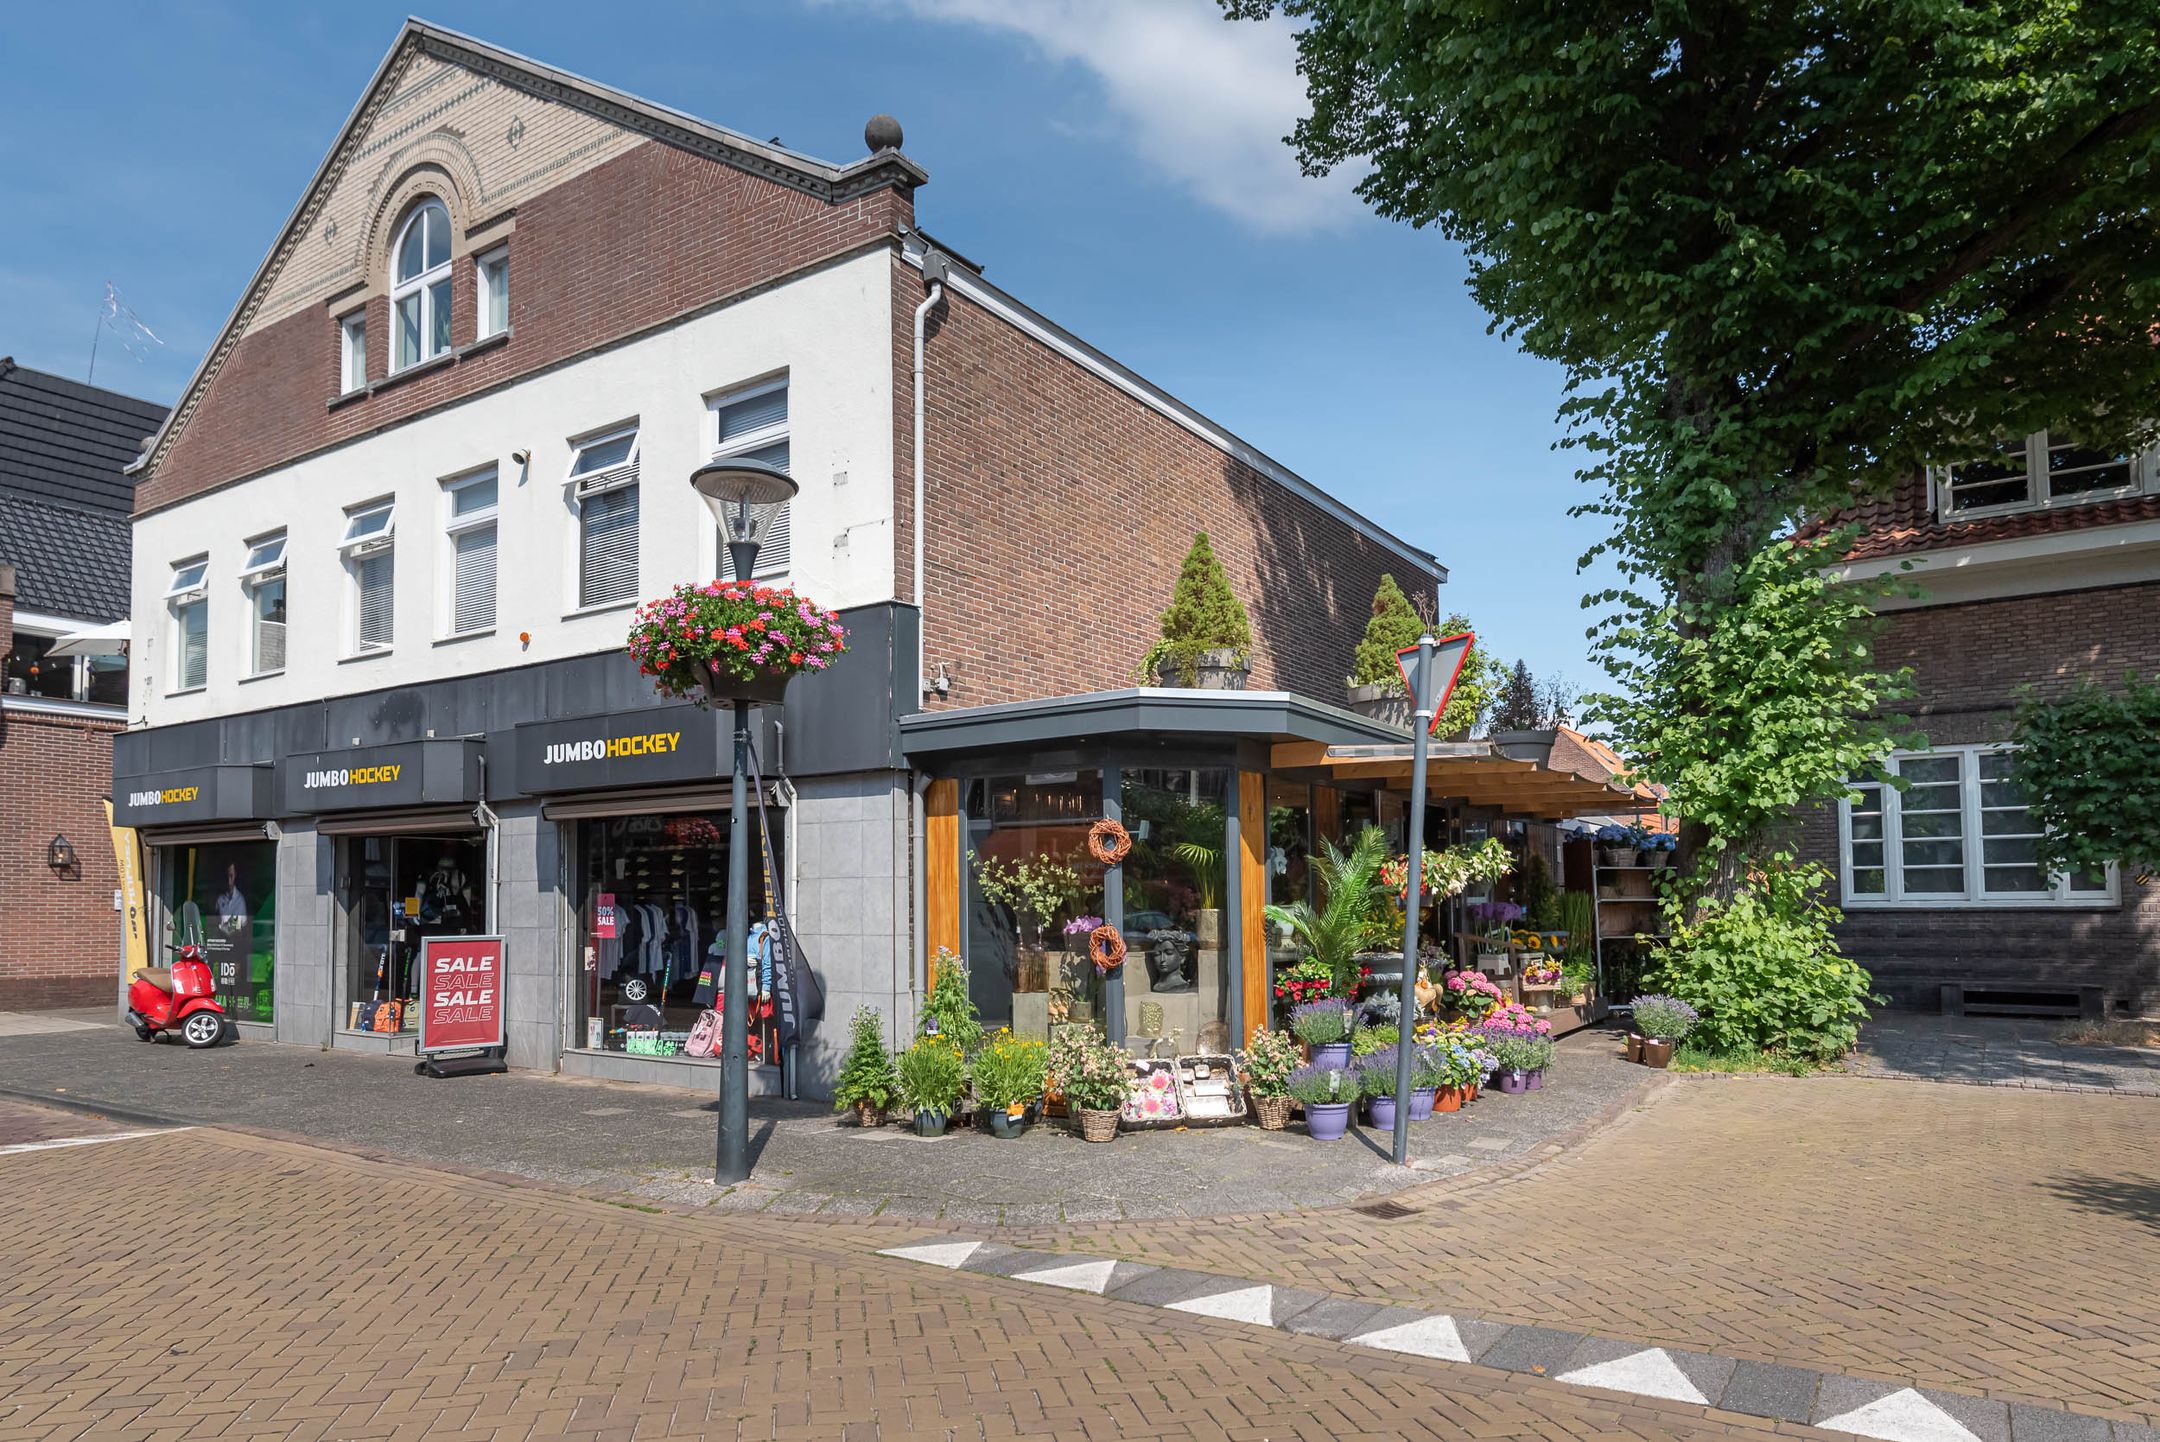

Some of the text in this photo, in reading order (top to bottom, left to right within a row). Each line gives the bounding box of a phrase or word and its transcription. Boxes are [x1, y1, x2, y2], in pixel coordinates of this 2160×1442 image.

[597, 906, 614, 917] 50%
[597, 916, 615, 926] SALE
[434, 956, 494, 973] SALE
[433, 972, 494, 990] SALE
[433, 989, 494, 1008] SALE
[432, 1006, 494, 1024] SALE
